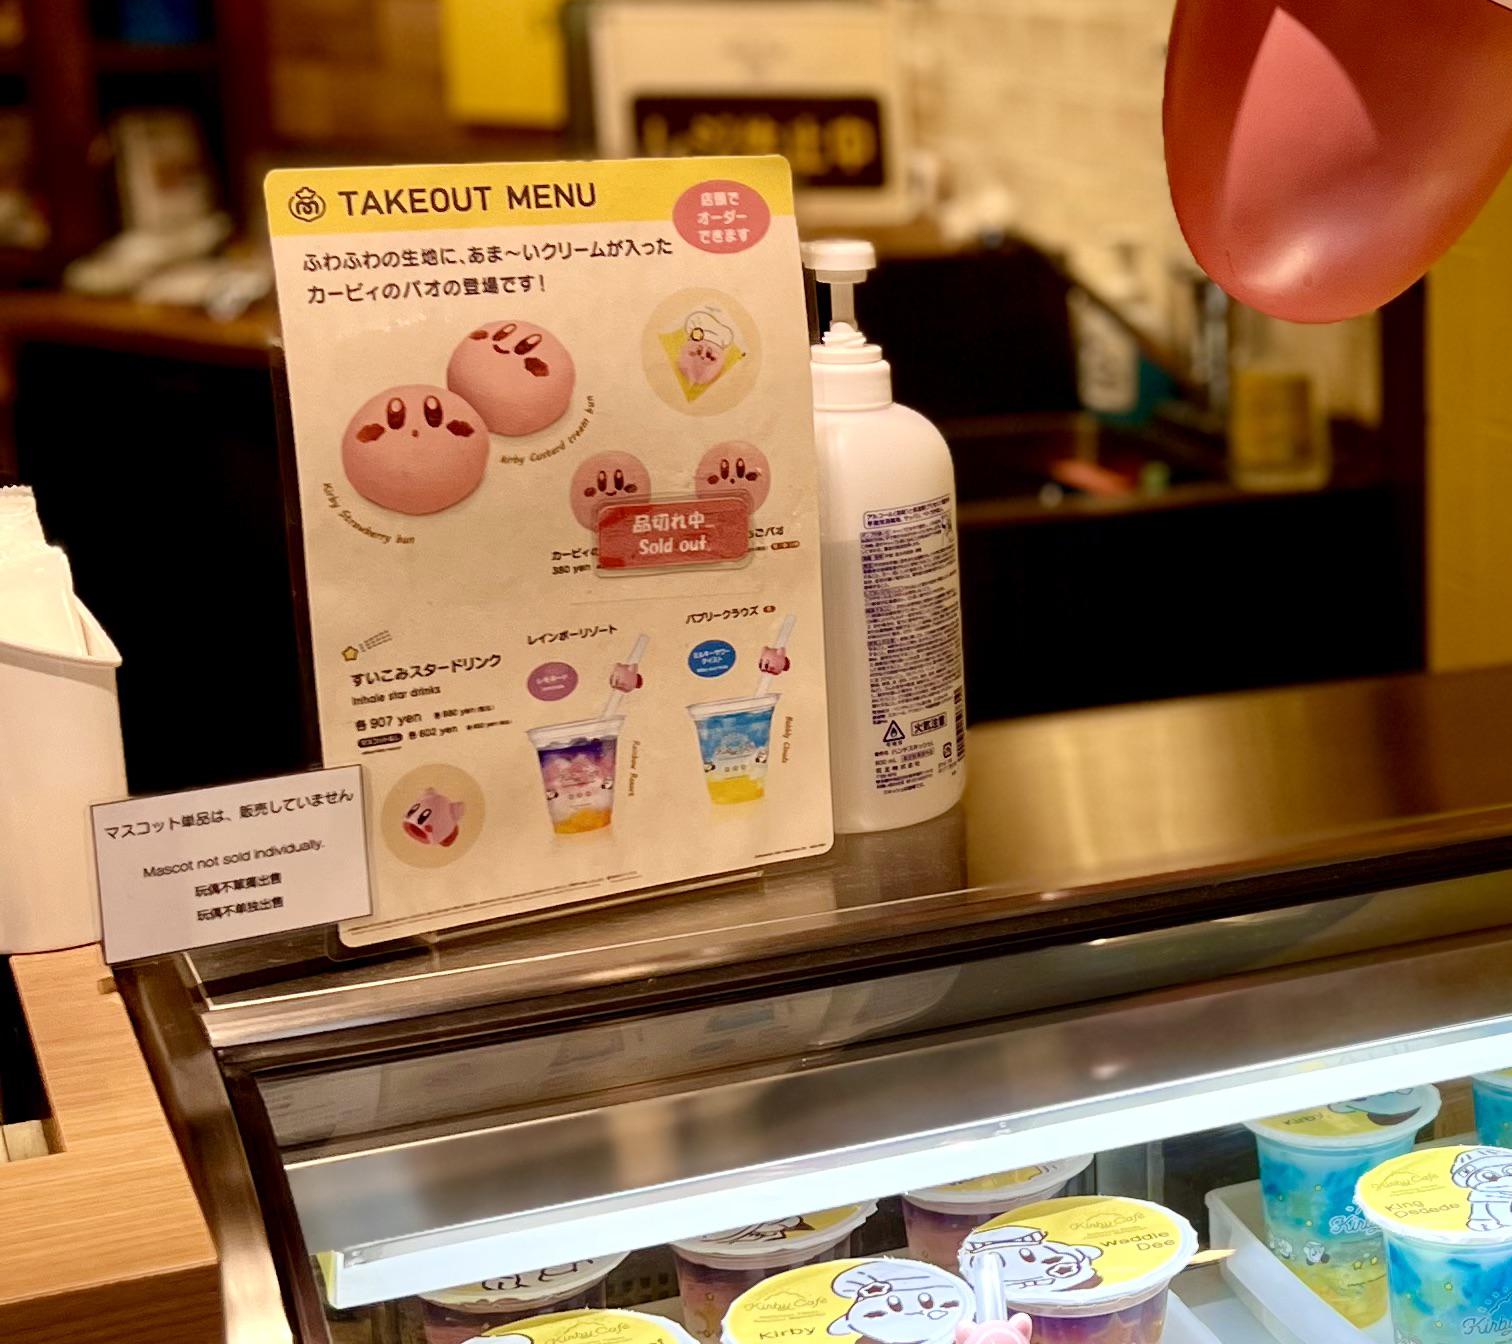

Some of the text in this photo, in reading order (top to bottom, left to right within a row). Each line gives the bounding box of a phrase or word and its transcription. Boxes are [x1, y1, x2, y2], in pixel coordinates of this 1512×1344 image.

[337, 183, 596, 216] TAKEOUT MENU
[632, 511, 705, 533] 品切れ中
[638, 535, 707, 555] Sold out
[527, 624, 618, 645] レインボーリゾート
[350, 654, 502, 687] すいこみスタードリンク
[370, 716, 393, 729] 907
[397, 713, 422, 726] yen
[143, 837, 326, 878] Mascot not sold individually.
[1100, 1232, 1170, 1247] Waddle
[1136, 1239, 1175, 1251] Dee
[759, 1326, 816, 1340] Kirby
